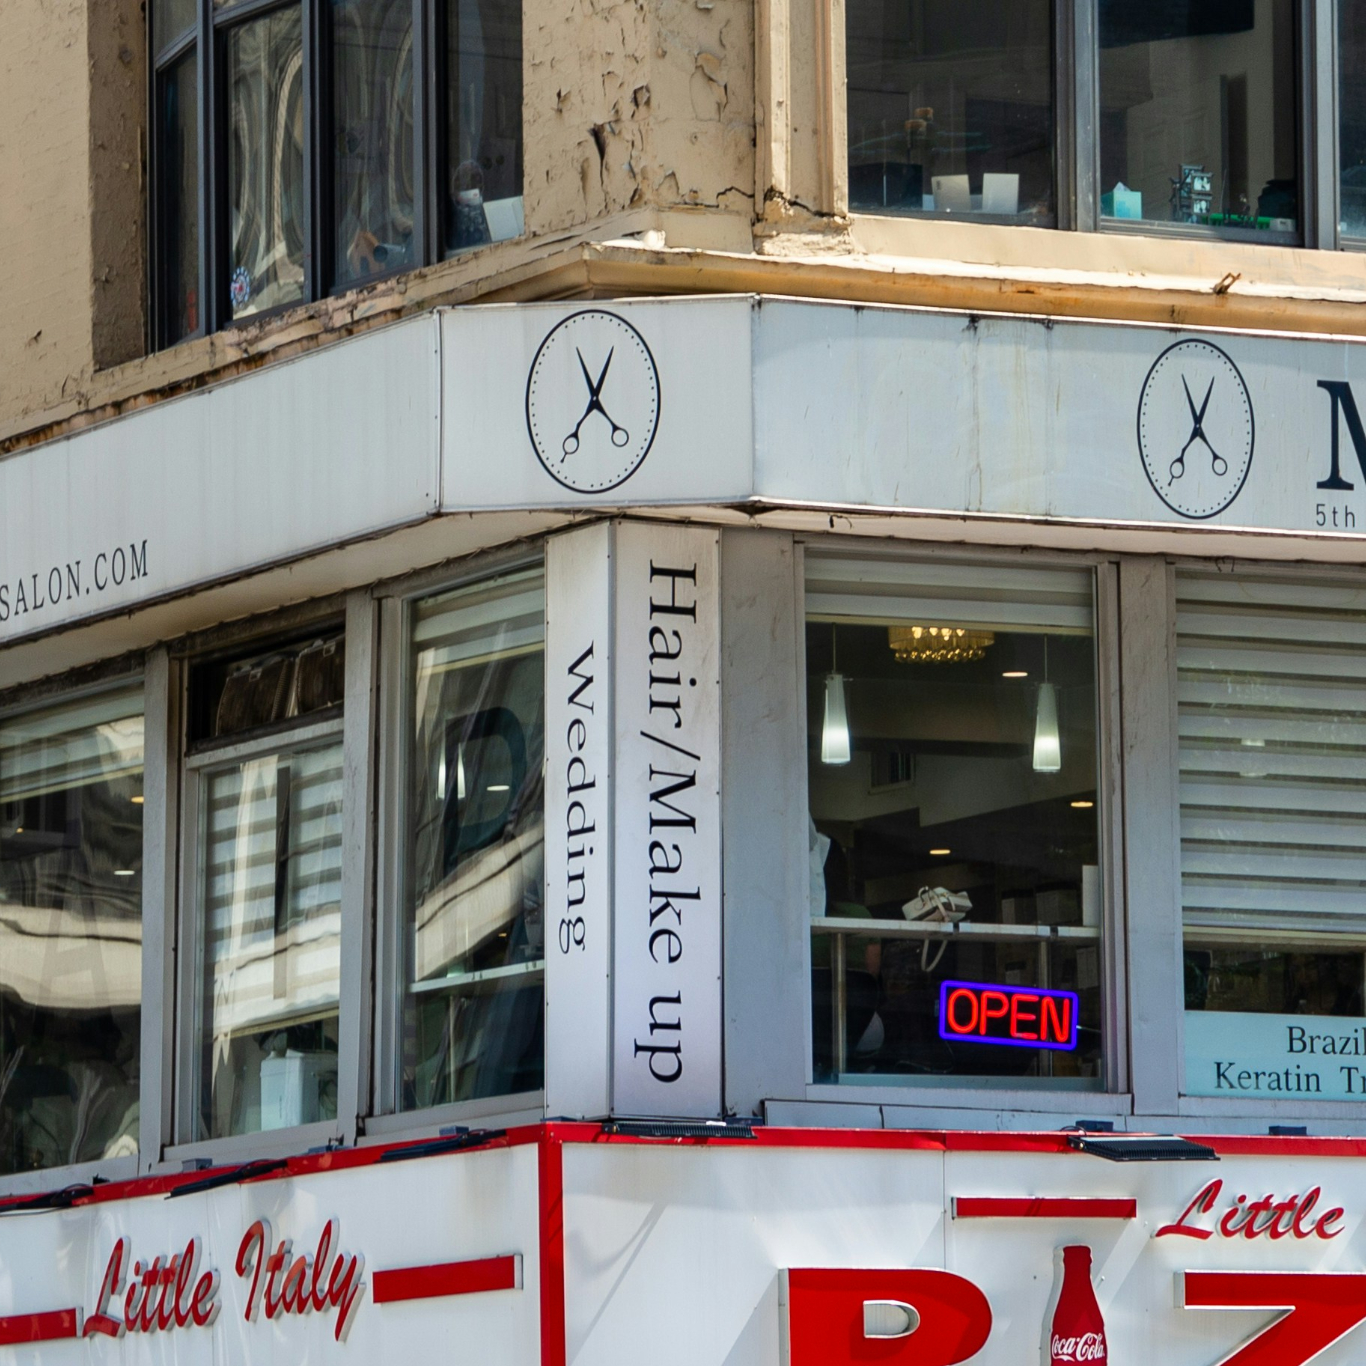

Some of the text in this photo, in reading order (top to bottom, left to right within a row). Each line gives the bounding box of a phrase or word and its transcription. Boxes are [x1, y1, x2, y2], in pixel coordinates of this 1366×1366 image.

[1315, 502, 1356, 528] 5th
[559, 639, 596, 955] Wedding
[634, 559, 701, 1084] Hair/Make up
[946, 989, 1071, 1043] OPEN
[1214, 1062, 1321, 1094] Keratin
[1155, 1178, 1345, 1242] Little
[83, 1217, 365, 1343] Little Italy
[1051, 1331, 1106, 1364] Coca-Cola
